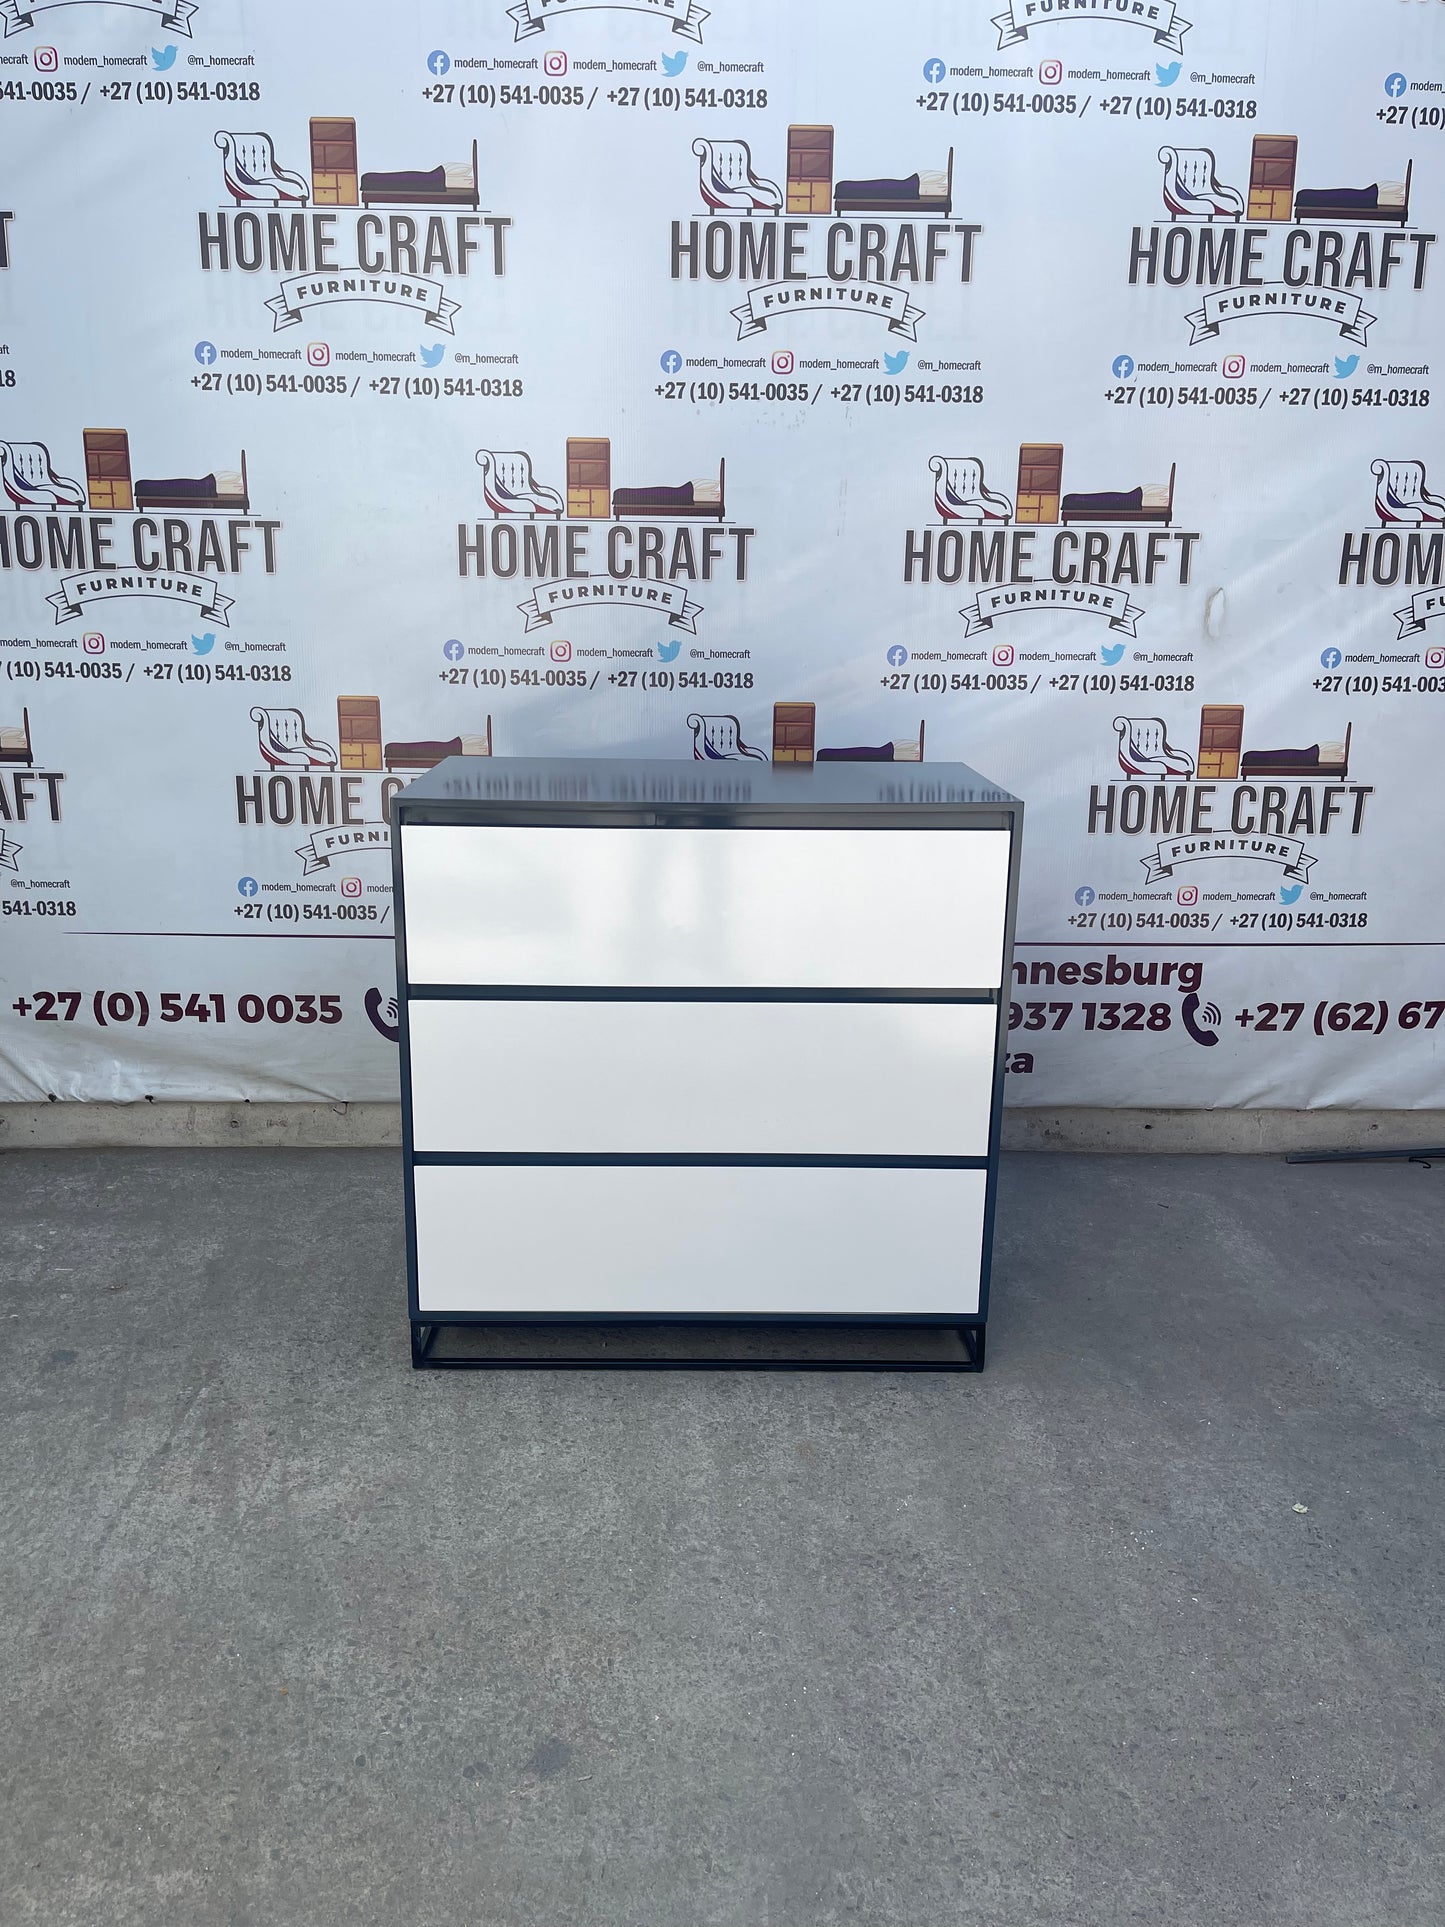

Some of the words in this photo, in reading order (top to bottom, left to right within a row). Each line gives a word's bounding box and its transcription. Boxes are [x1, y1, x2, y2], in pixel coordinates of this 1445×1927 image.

[188, 55, 255, 68] @m_homecraft
[698, 60, 765, 74] @m_homecraft
[1190, 72, 1255, 86] @m_homecraft
[198, 213, 340, 272] HOME
[357, 214, 512, 274] CRAFT
[671, 221, 809, 281] HOME
[827, 222, 982, 283] CRAFT
[1128, 227, 1268, 286] HOME
[1283, 229, 1436, 290] CRAFT
[297, 280, 428, 301] FURNITURE
[764, 288, 894, 310] FURNITURE
[1218, 293, 1346, 314] FURNITURE
[454, 352, 518, 365] @m_homecraft
[918, 360, 982, 372] @m_homecraft
[1367, 363, 1430, 376] @m_homecraft
[133, 518, 281, 572] CRAFT
[459, 524, 590, 578] HOME
[607, 526, 755, 580] CRAFT
[904, 530, 1036, 584] HOME
[1052, 531, 1200, 586] CRAFT
[77, 578, 202, 598] FURNITURE
[548, 585, 672, 604] FURNITURE
[990, 589, 1114, 609] FURNITURE
[224, 640, 286, 652] @m_homecraft
[690, 648, 750, 660] @m_homecraft
[1133, 651, 1194, 664] @m_homecraft
[236, 776, 364, 824] HOME
[1088, 785, 1215, 834] HOME
[1232, 786, 1373, 834] CRAFT
[1172, 840, 1290, 858] FURNITURE
[10, 879, 70, 889] @m_homecraft
[1310, 891, 1368, 902] @m_homecraft
[12, 992, 82, 1020] +27
[94, 991, 150, 1026] (0)
[160, 993, 225, 1022] 541
[238, 994, 342, 1024] 0035
[1082, 1002, 1171, 1031] 1328
[1234, 1003, 1304, 1032] +27
[1313, 1001, 1388, 1036] (62)
